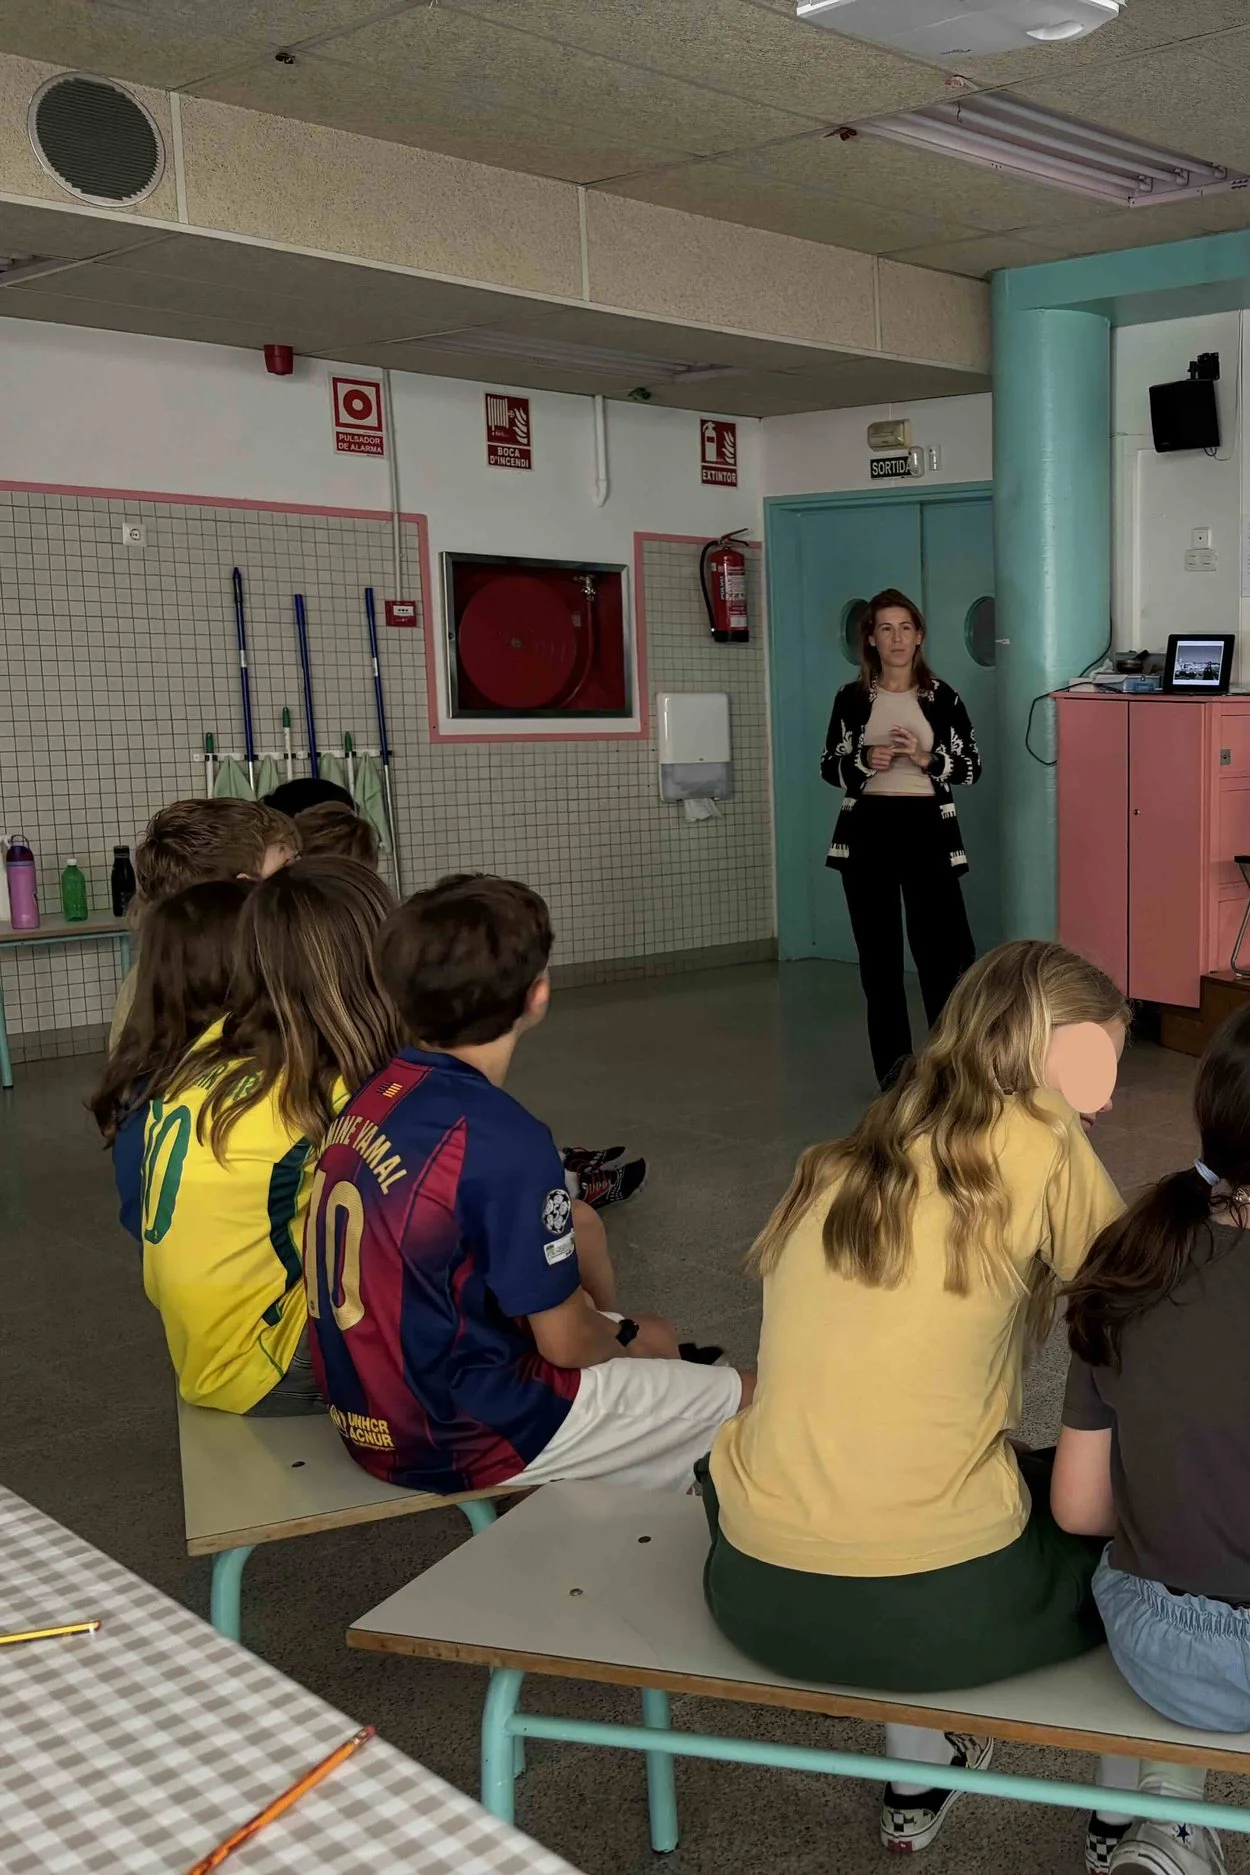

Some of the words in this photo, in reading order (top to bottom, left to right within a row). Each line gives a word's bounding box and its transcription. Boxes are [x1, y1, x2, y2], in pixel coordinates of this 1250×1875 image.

[339, 434, 381, 445] PULSADOR
[350, 444, 382, 453] ALARMA
[497, 447, 520, 457] BOCA
[489, 455, 529, 468] D'INCENDI
[872, 459, 911, 475] SORTIDA
[703, 469, 736, 483] EXTINTOR
[352, 1119, 408, 1195] YAMAL
[303, 1167, 366, 1331] 10
[347, 1411, 389, 1433] UNHCR
[350, 1427, 395, 1447] ACNUR
